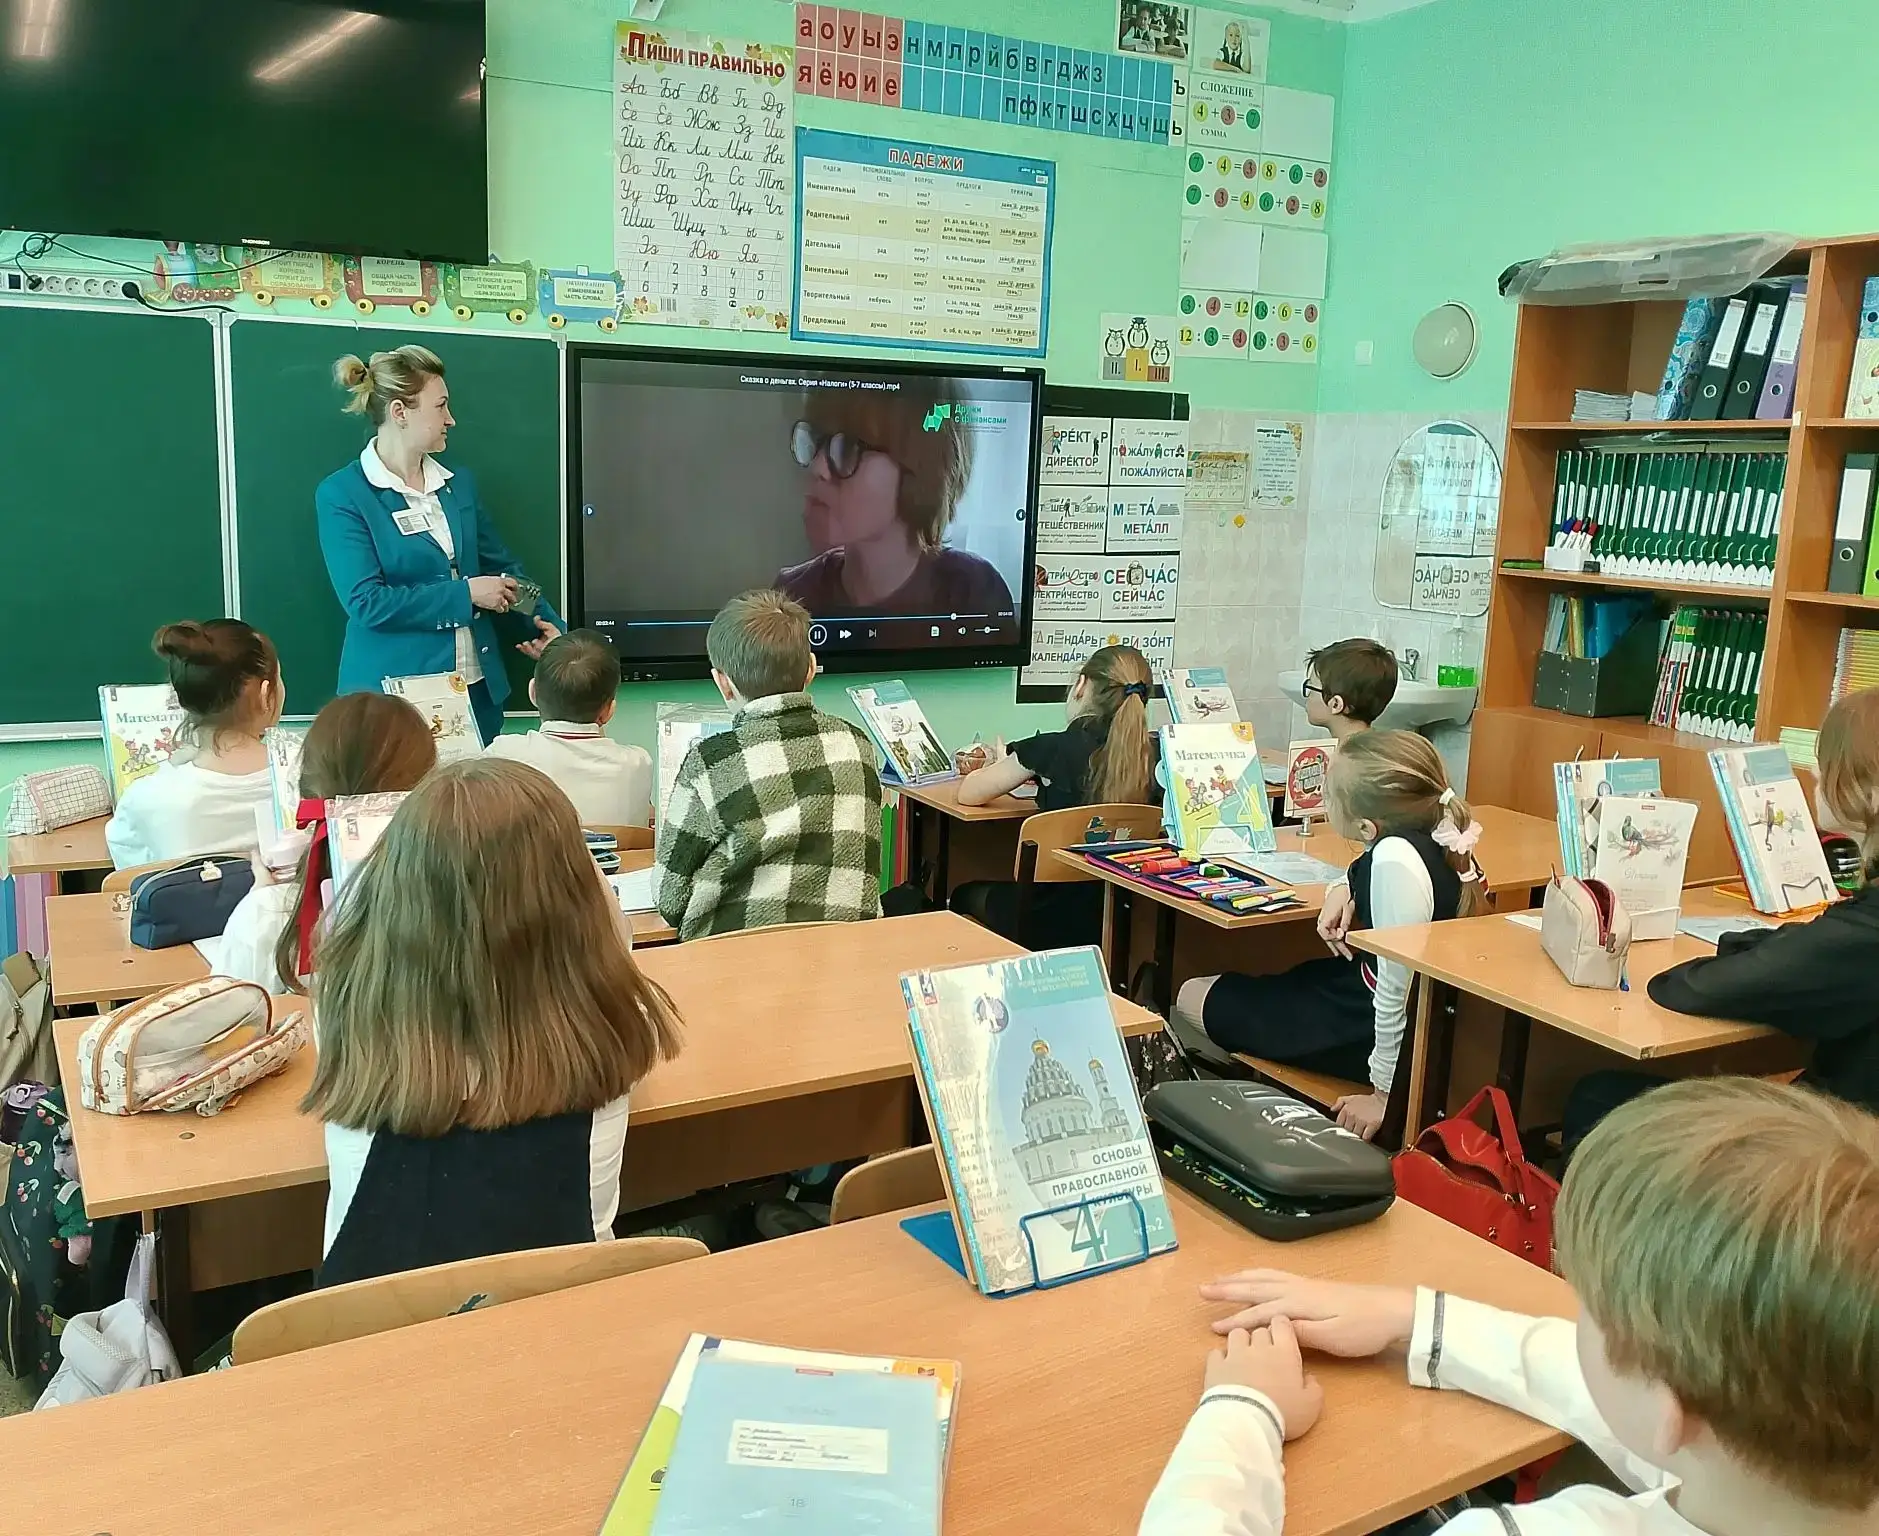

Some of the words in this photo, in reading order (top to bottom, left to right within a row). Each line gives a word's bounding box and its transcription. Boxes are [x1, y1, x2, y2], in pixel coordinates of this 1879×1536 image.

[889, 149, 963, 171] ПАДЕЖИ
[1039, 516, 1104, 531] ТЕШЕ́СТВЕННИК
[1035, 587, 1099, 601] ЛЕКТРИ́ЧЕСТВО
[116, 712, 184, 724] Математи
[1093, 1144, 1143, 1166] ОСНОВЫ
[1052, 1161, 1149, 1197] ПРАВОСЛАВНОЙ
[1071, 1193, 1105, 1263] 4
